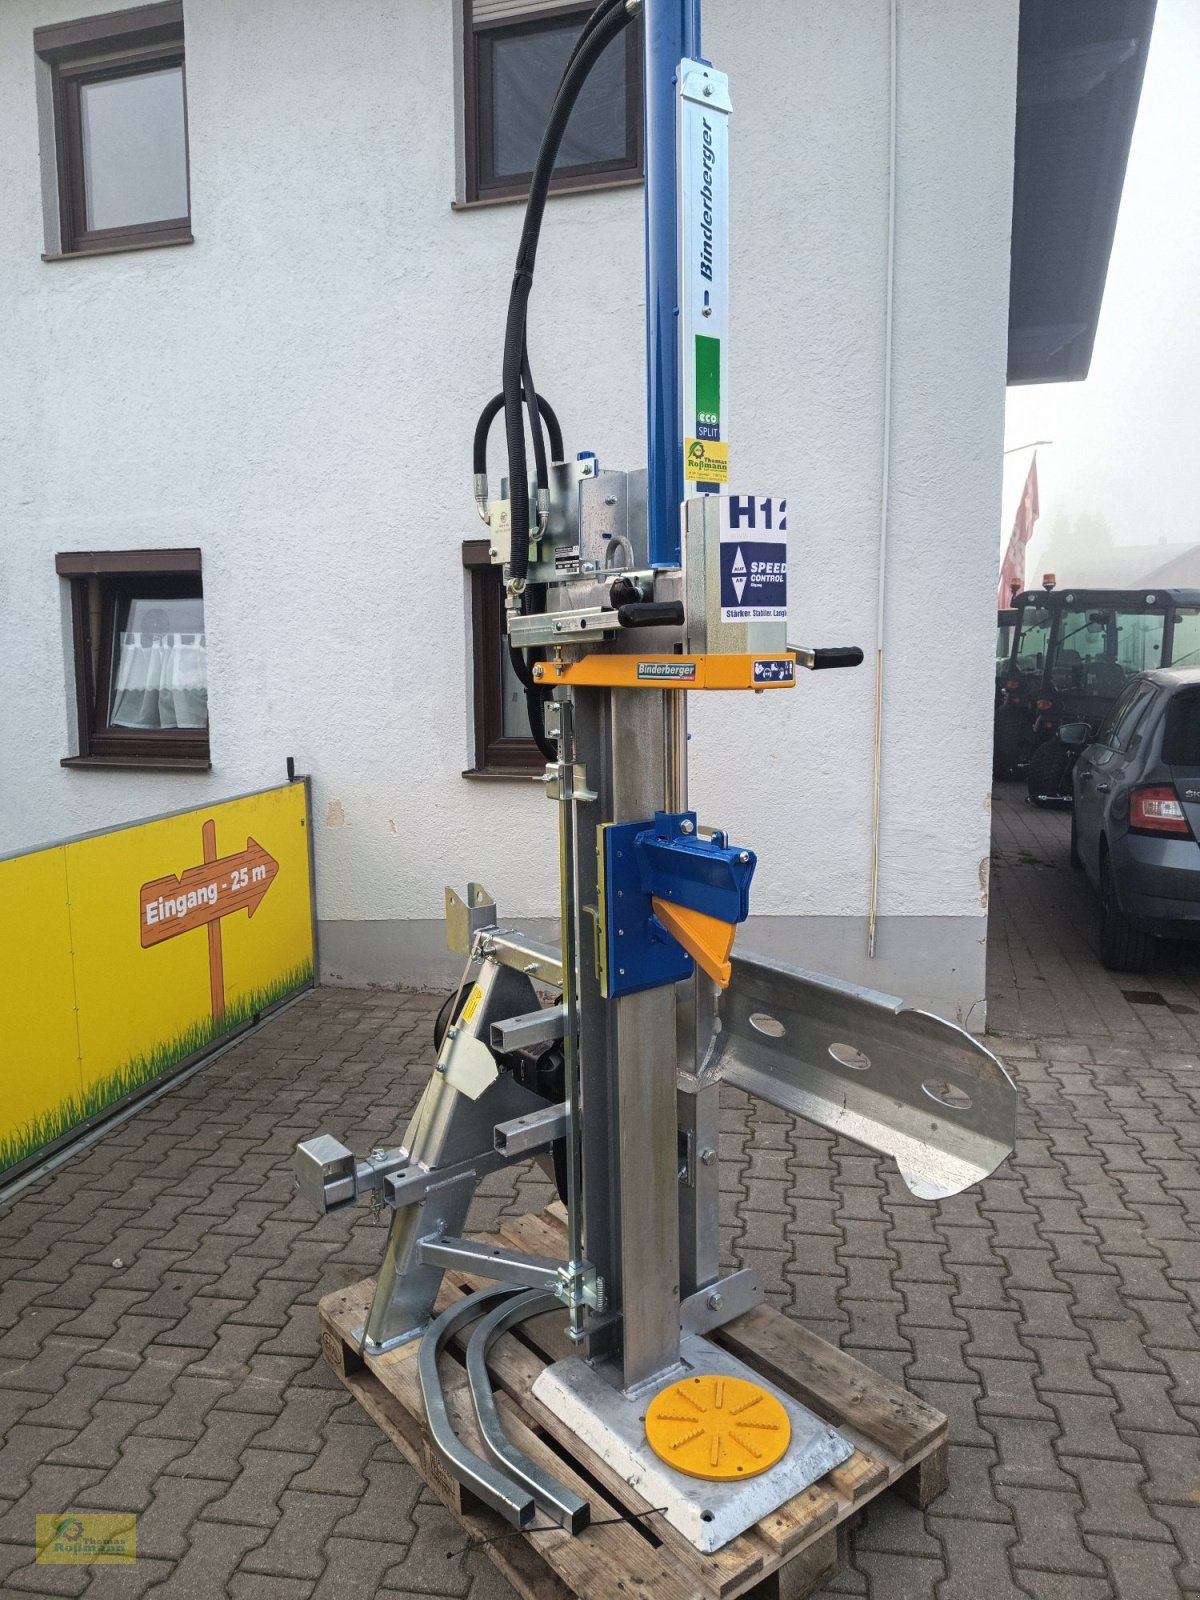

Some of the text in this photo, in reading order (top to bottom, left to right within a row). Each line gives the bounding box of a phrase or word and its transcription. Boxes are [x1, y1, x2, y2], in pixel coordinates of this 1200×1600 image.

[700, 117, 715, 282] Binderberger
[699, 413, 717, 423] eco
[698, 426, 718, 438] SPLIT
[688, 460, 727, 470] Roßmann
[750, 574, 784, 582] CONTROL
[638, 664, 694, 676] Binderberger
[146, 883, 217, 925] Eingang
[231, 867, 248, 891] 25
[252, 864, 266, 882] m
